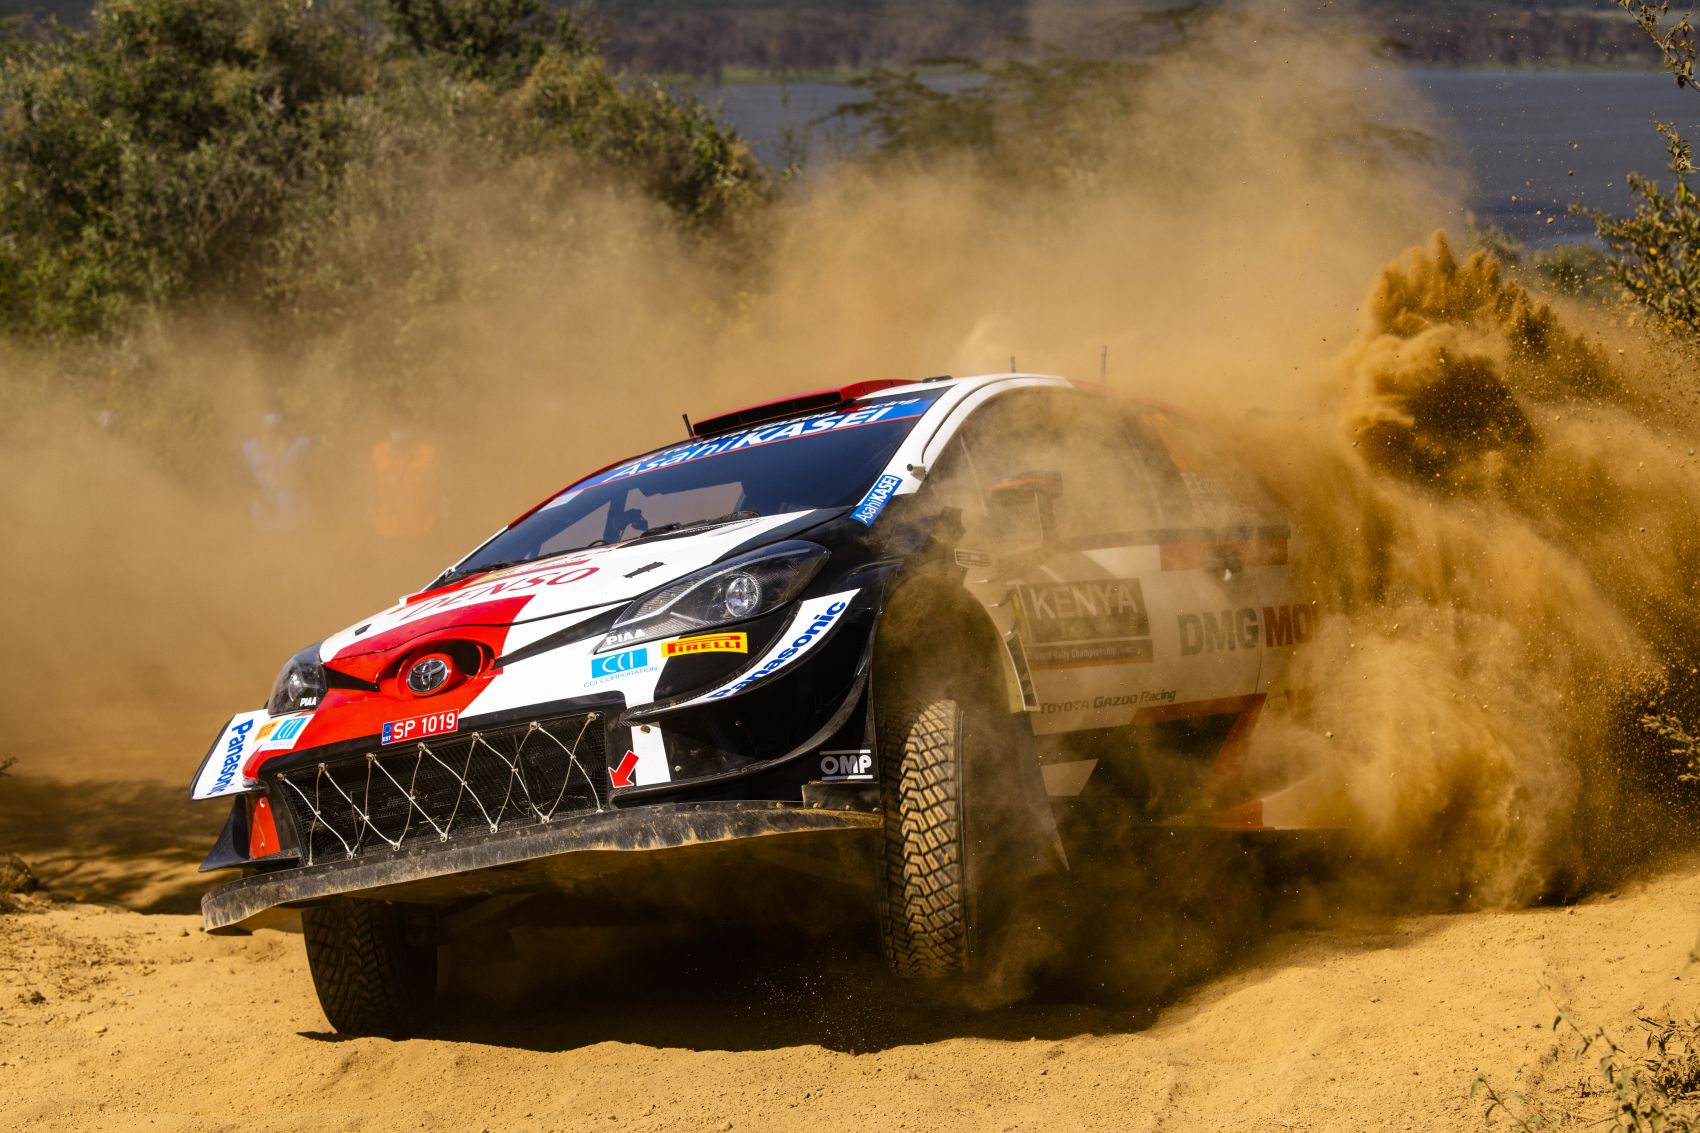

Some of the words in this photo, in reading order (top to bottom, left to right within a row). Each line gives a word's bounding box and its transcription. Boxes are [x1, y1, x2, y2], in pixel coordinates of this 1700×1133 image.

[855, 475, 901, 523] AsahiKASEI
[1029, 582, 1138, 619] KENYA
[606, 628, 646, 645] PIAA
[667, 635, 741, 654] PIRELLI
[1177, 607, 1259, 656] DMG
[601, 651, 634, 673] CCI
[706, 601, 847, 699] Panasonic
[599, 665, 659, 684] CORPORATION
[1040, 700, 1090, 715] TOYOTA
[1092, 694, 1139, 709] GAZOO
[1140, 689, 1177, 703] Racing
[393, 719, 416, 740] SP
[421, 712, 456, 735] 1019
[820, 754, 872, 776] OMP
